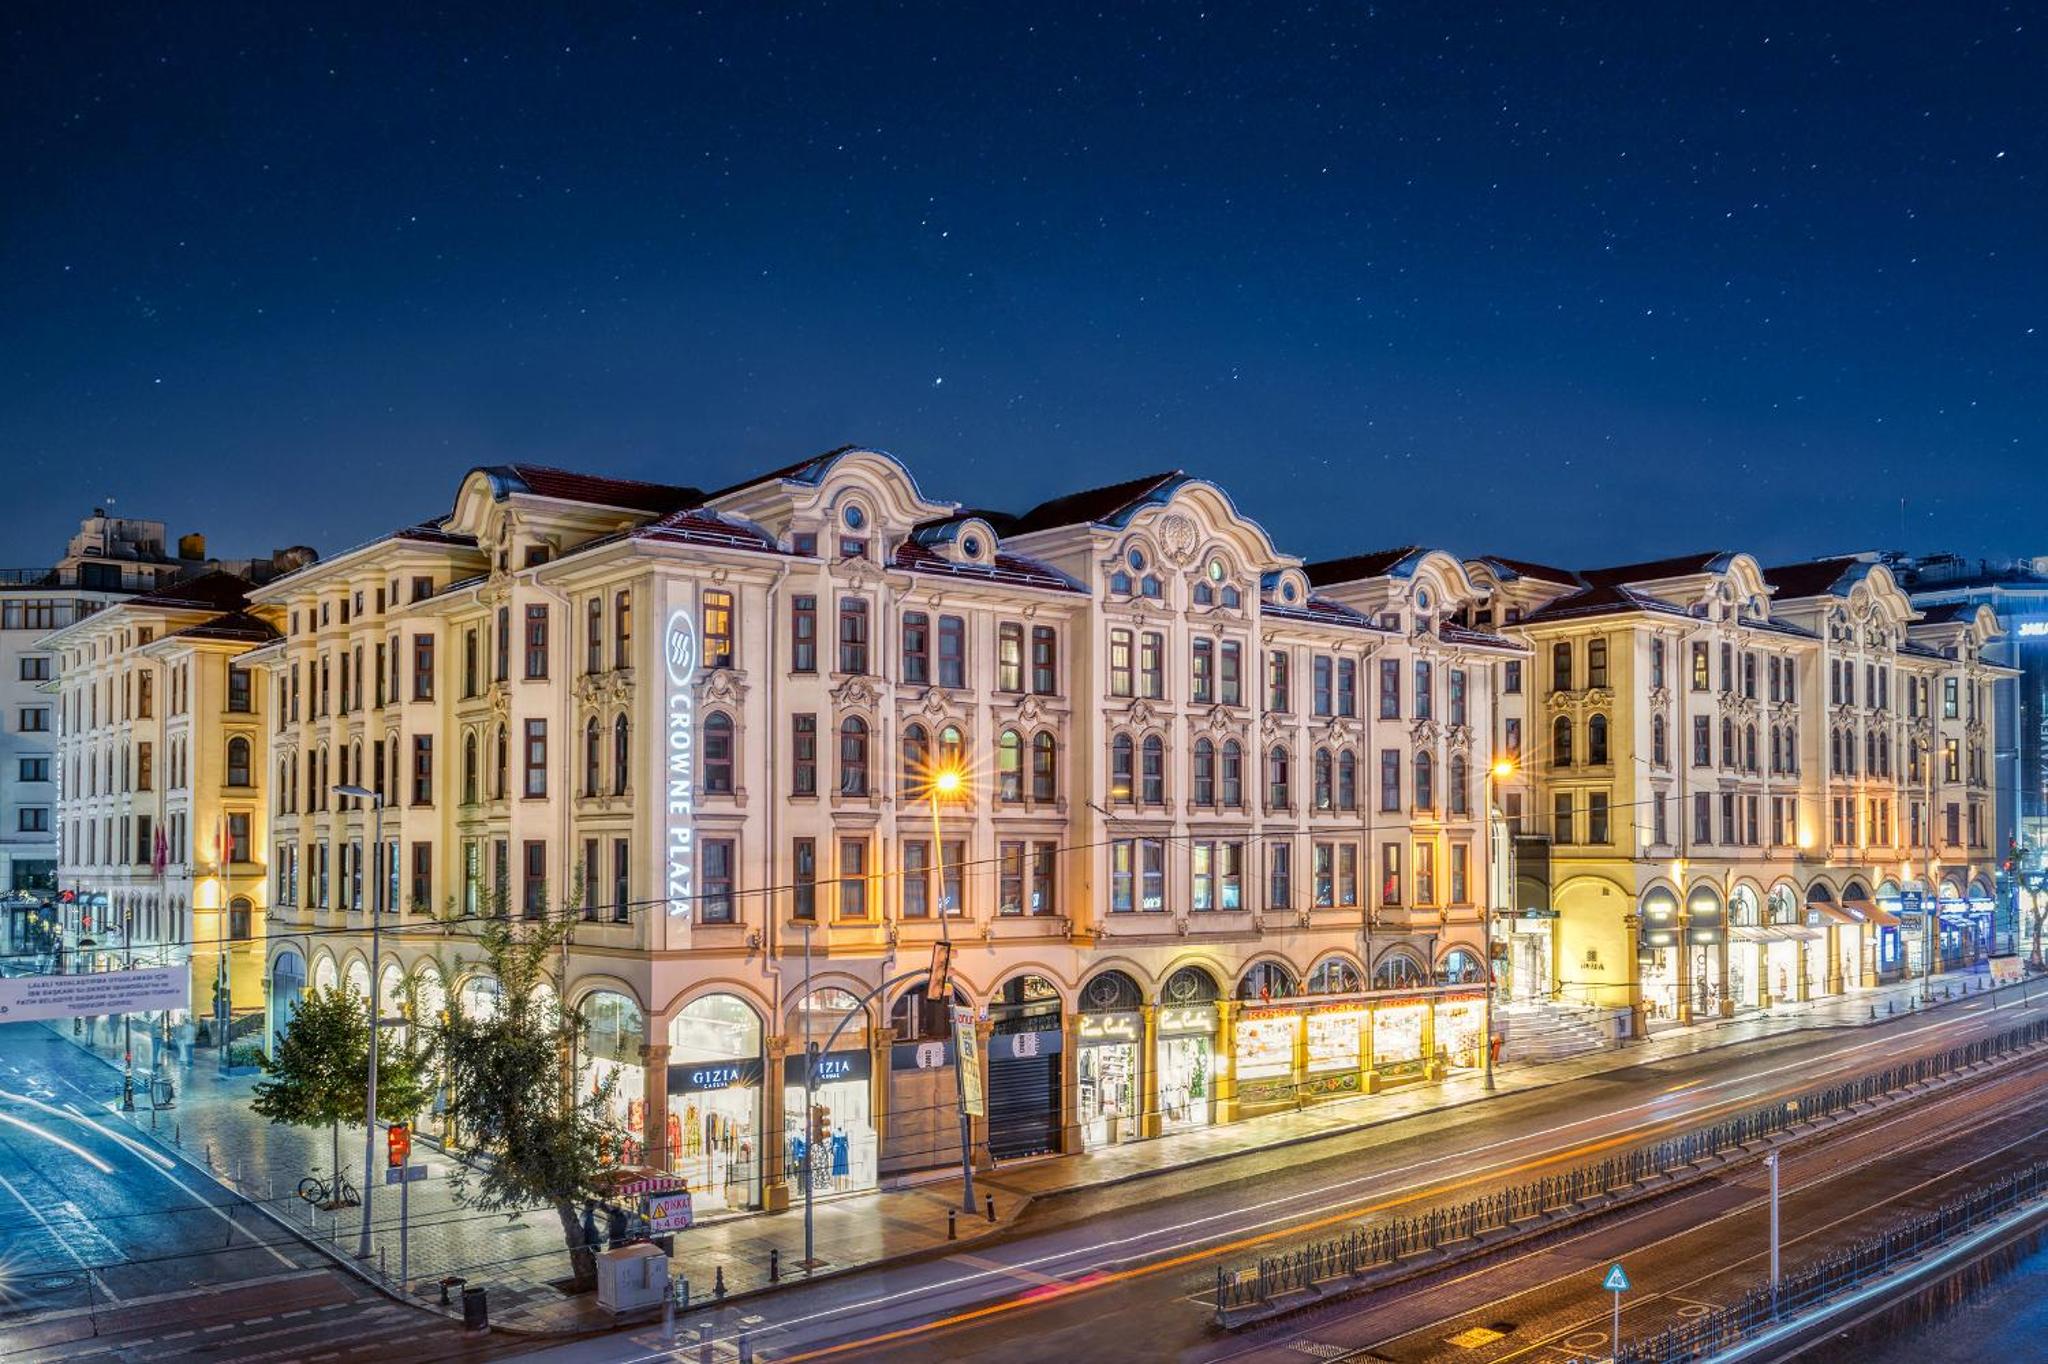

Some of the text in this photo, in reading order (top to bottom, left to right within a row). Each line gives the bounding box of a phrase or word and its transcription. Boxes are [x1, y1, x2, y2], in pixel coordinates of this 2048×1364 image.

[669, 694, 691, 917] CROWNE PLAZA
[1249, 1009, 1297, 1020] KOSKA
[1320, 1003, 1364, 1013] KOSKA
[819, 1060, 850, 1074] IZIA
[693, 1069, 739, 1084] GIZIA
